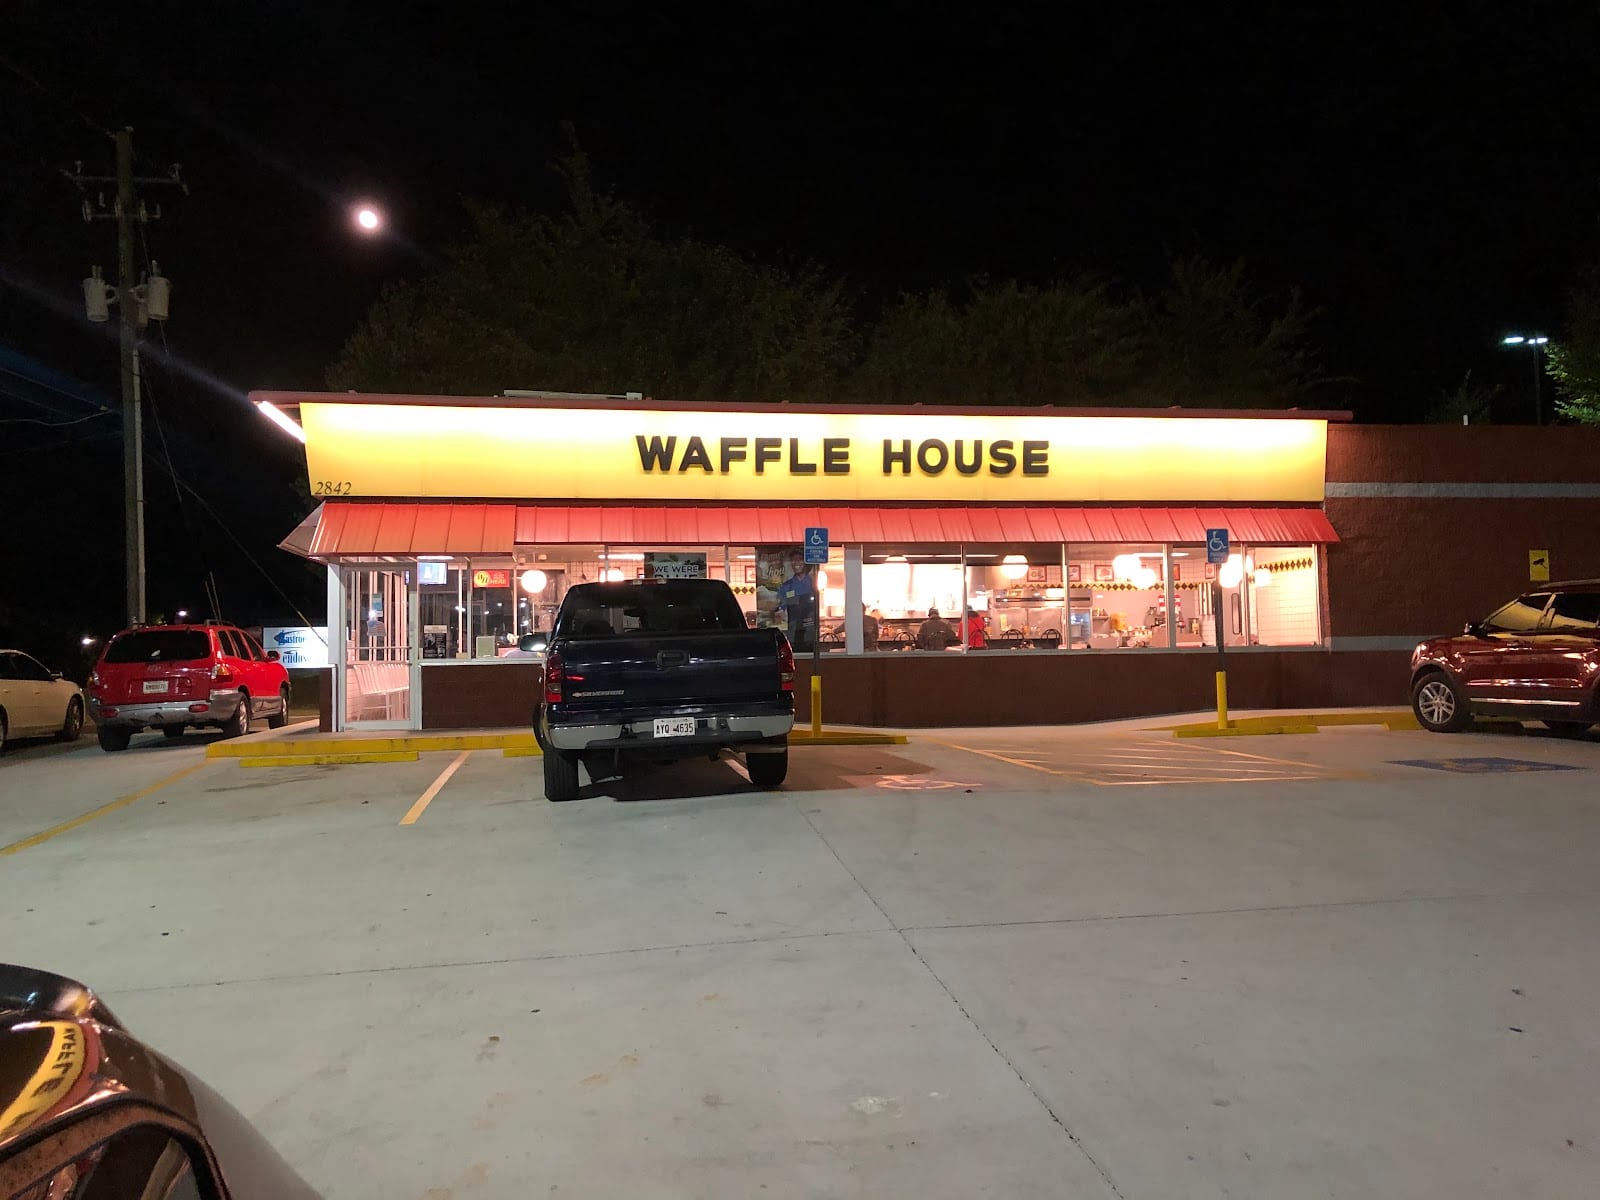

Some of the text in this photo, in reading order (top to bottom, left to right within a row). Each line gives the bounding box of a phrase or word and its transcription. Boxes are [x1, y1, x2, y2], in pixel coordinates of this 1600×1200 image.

[636, 435, 1050, 476] WAFFLE HOUSE
[314, 481, 352, 495] 2842
[654, 565, 698, 573] WE WERE
[673, 722, 694, 734] 4635
